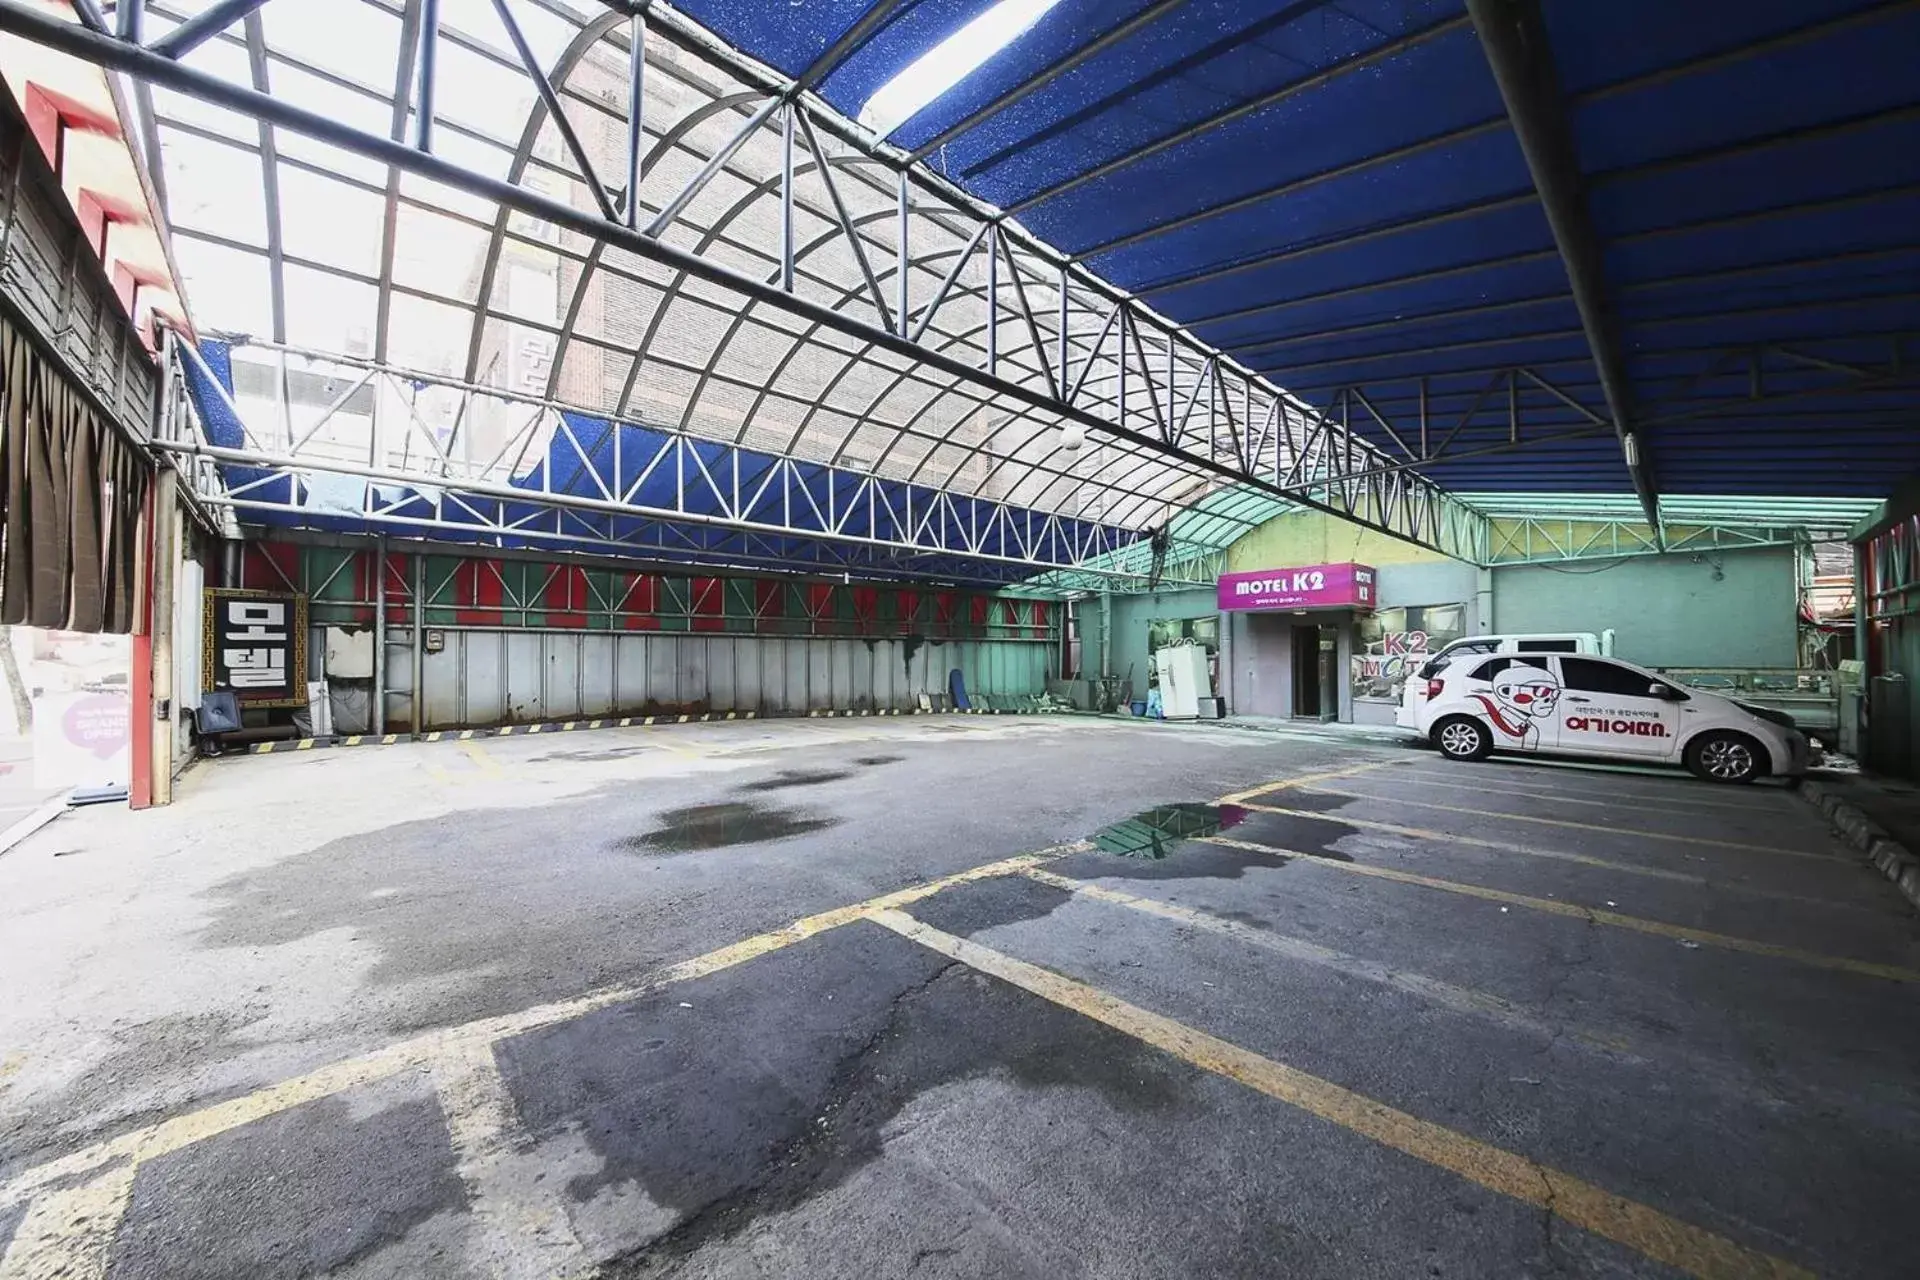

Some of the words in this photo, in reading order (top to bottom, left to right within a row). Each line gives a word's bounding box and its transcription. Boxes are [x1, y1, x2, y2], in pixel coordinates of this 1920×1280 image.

[1236, 579, 1288, 595] MOTEL
[1293, 571, 1325, 591] K2
[223, 601, 287, 688] 모텔
[1383, 630, 1429, 655] K2
[1575, 706, 1603, 714] 대한민국
